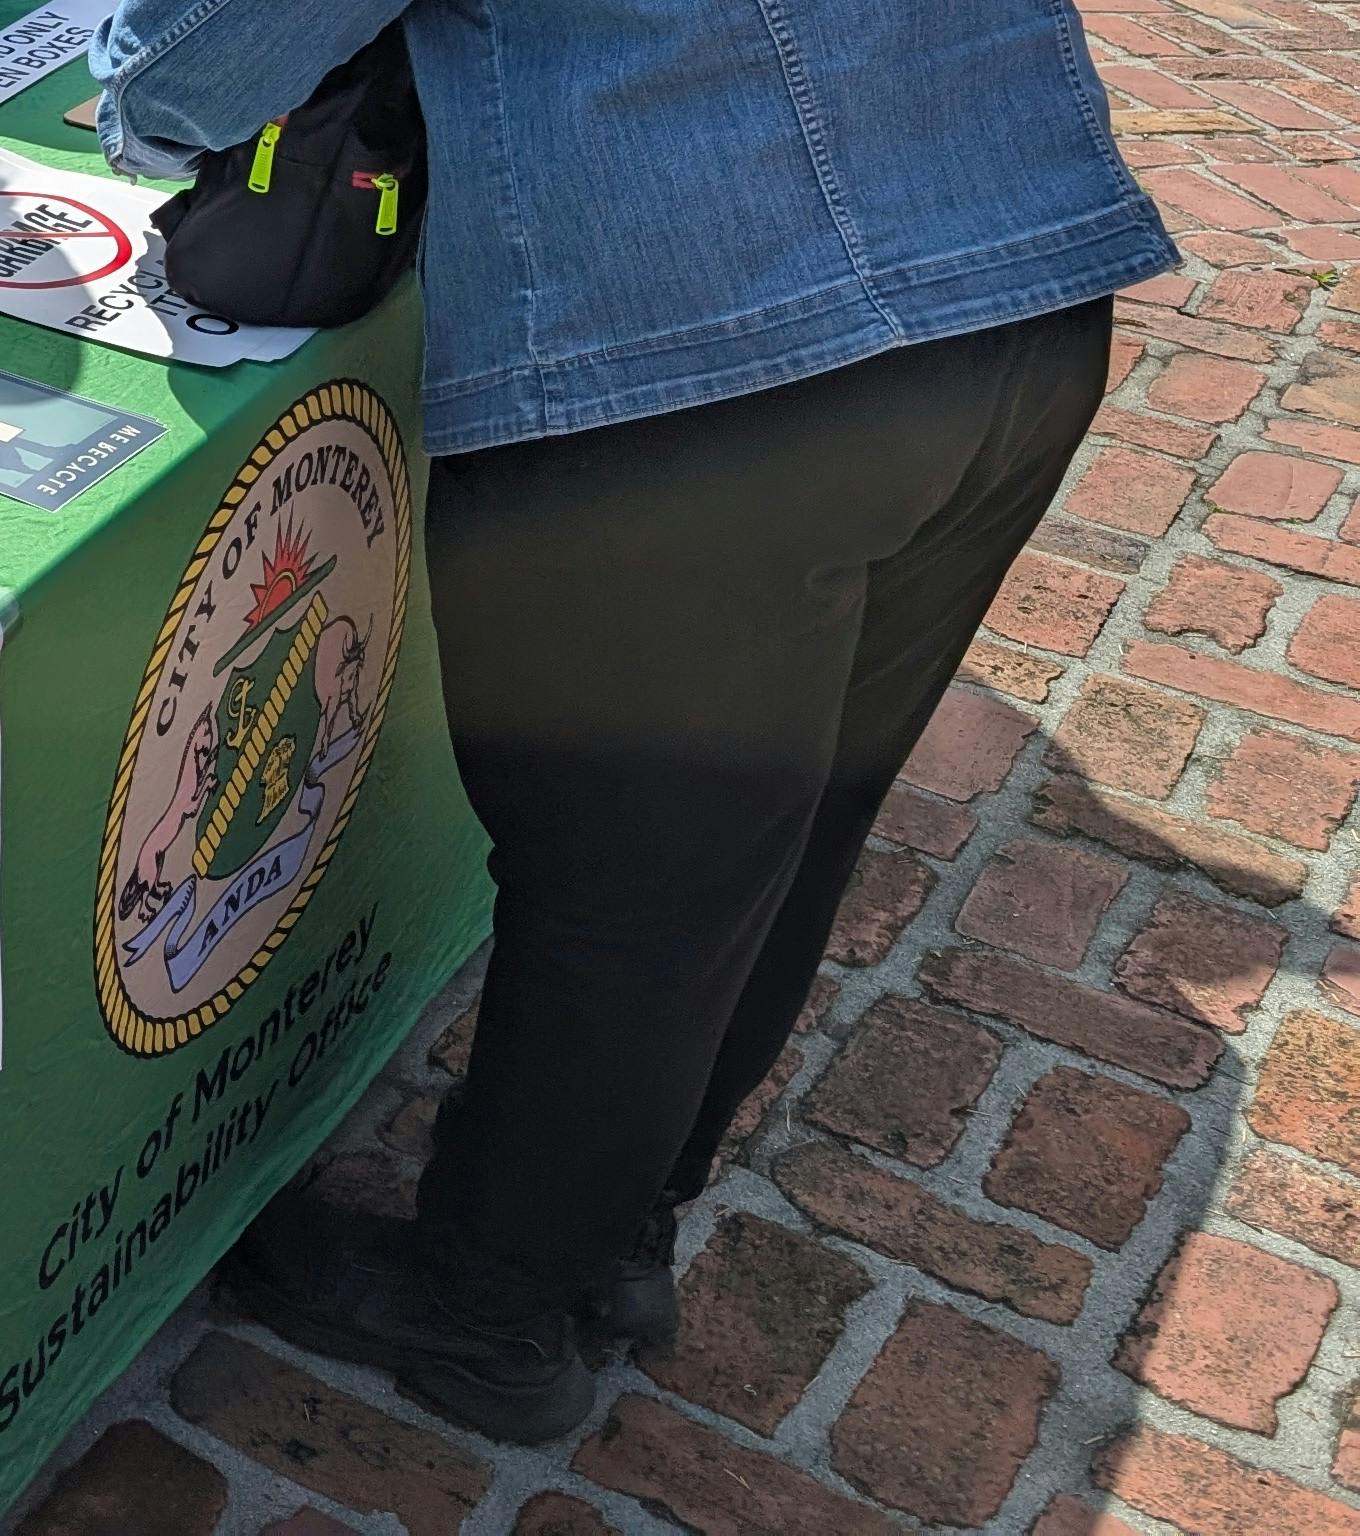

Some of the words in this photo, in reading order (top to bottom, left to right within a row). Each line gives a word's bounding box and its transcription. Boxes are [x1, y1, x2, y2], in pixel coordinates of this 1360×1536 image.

[1, 10, 70, 45] ONLY
[13, 25, 95, 68] BOXES
[185, 313, 240, 336] O
[156, 580, 217, 737] CITY
[222, 501, 261, 580] OF
[269, 444, 384, 549] MONTEREY
[287, 950, 393, 1089] Office
[38, 1166, 124, 1291] City
[137, 1091, 182, 1178] of
[191, 903, 378, 1124] Monterey
